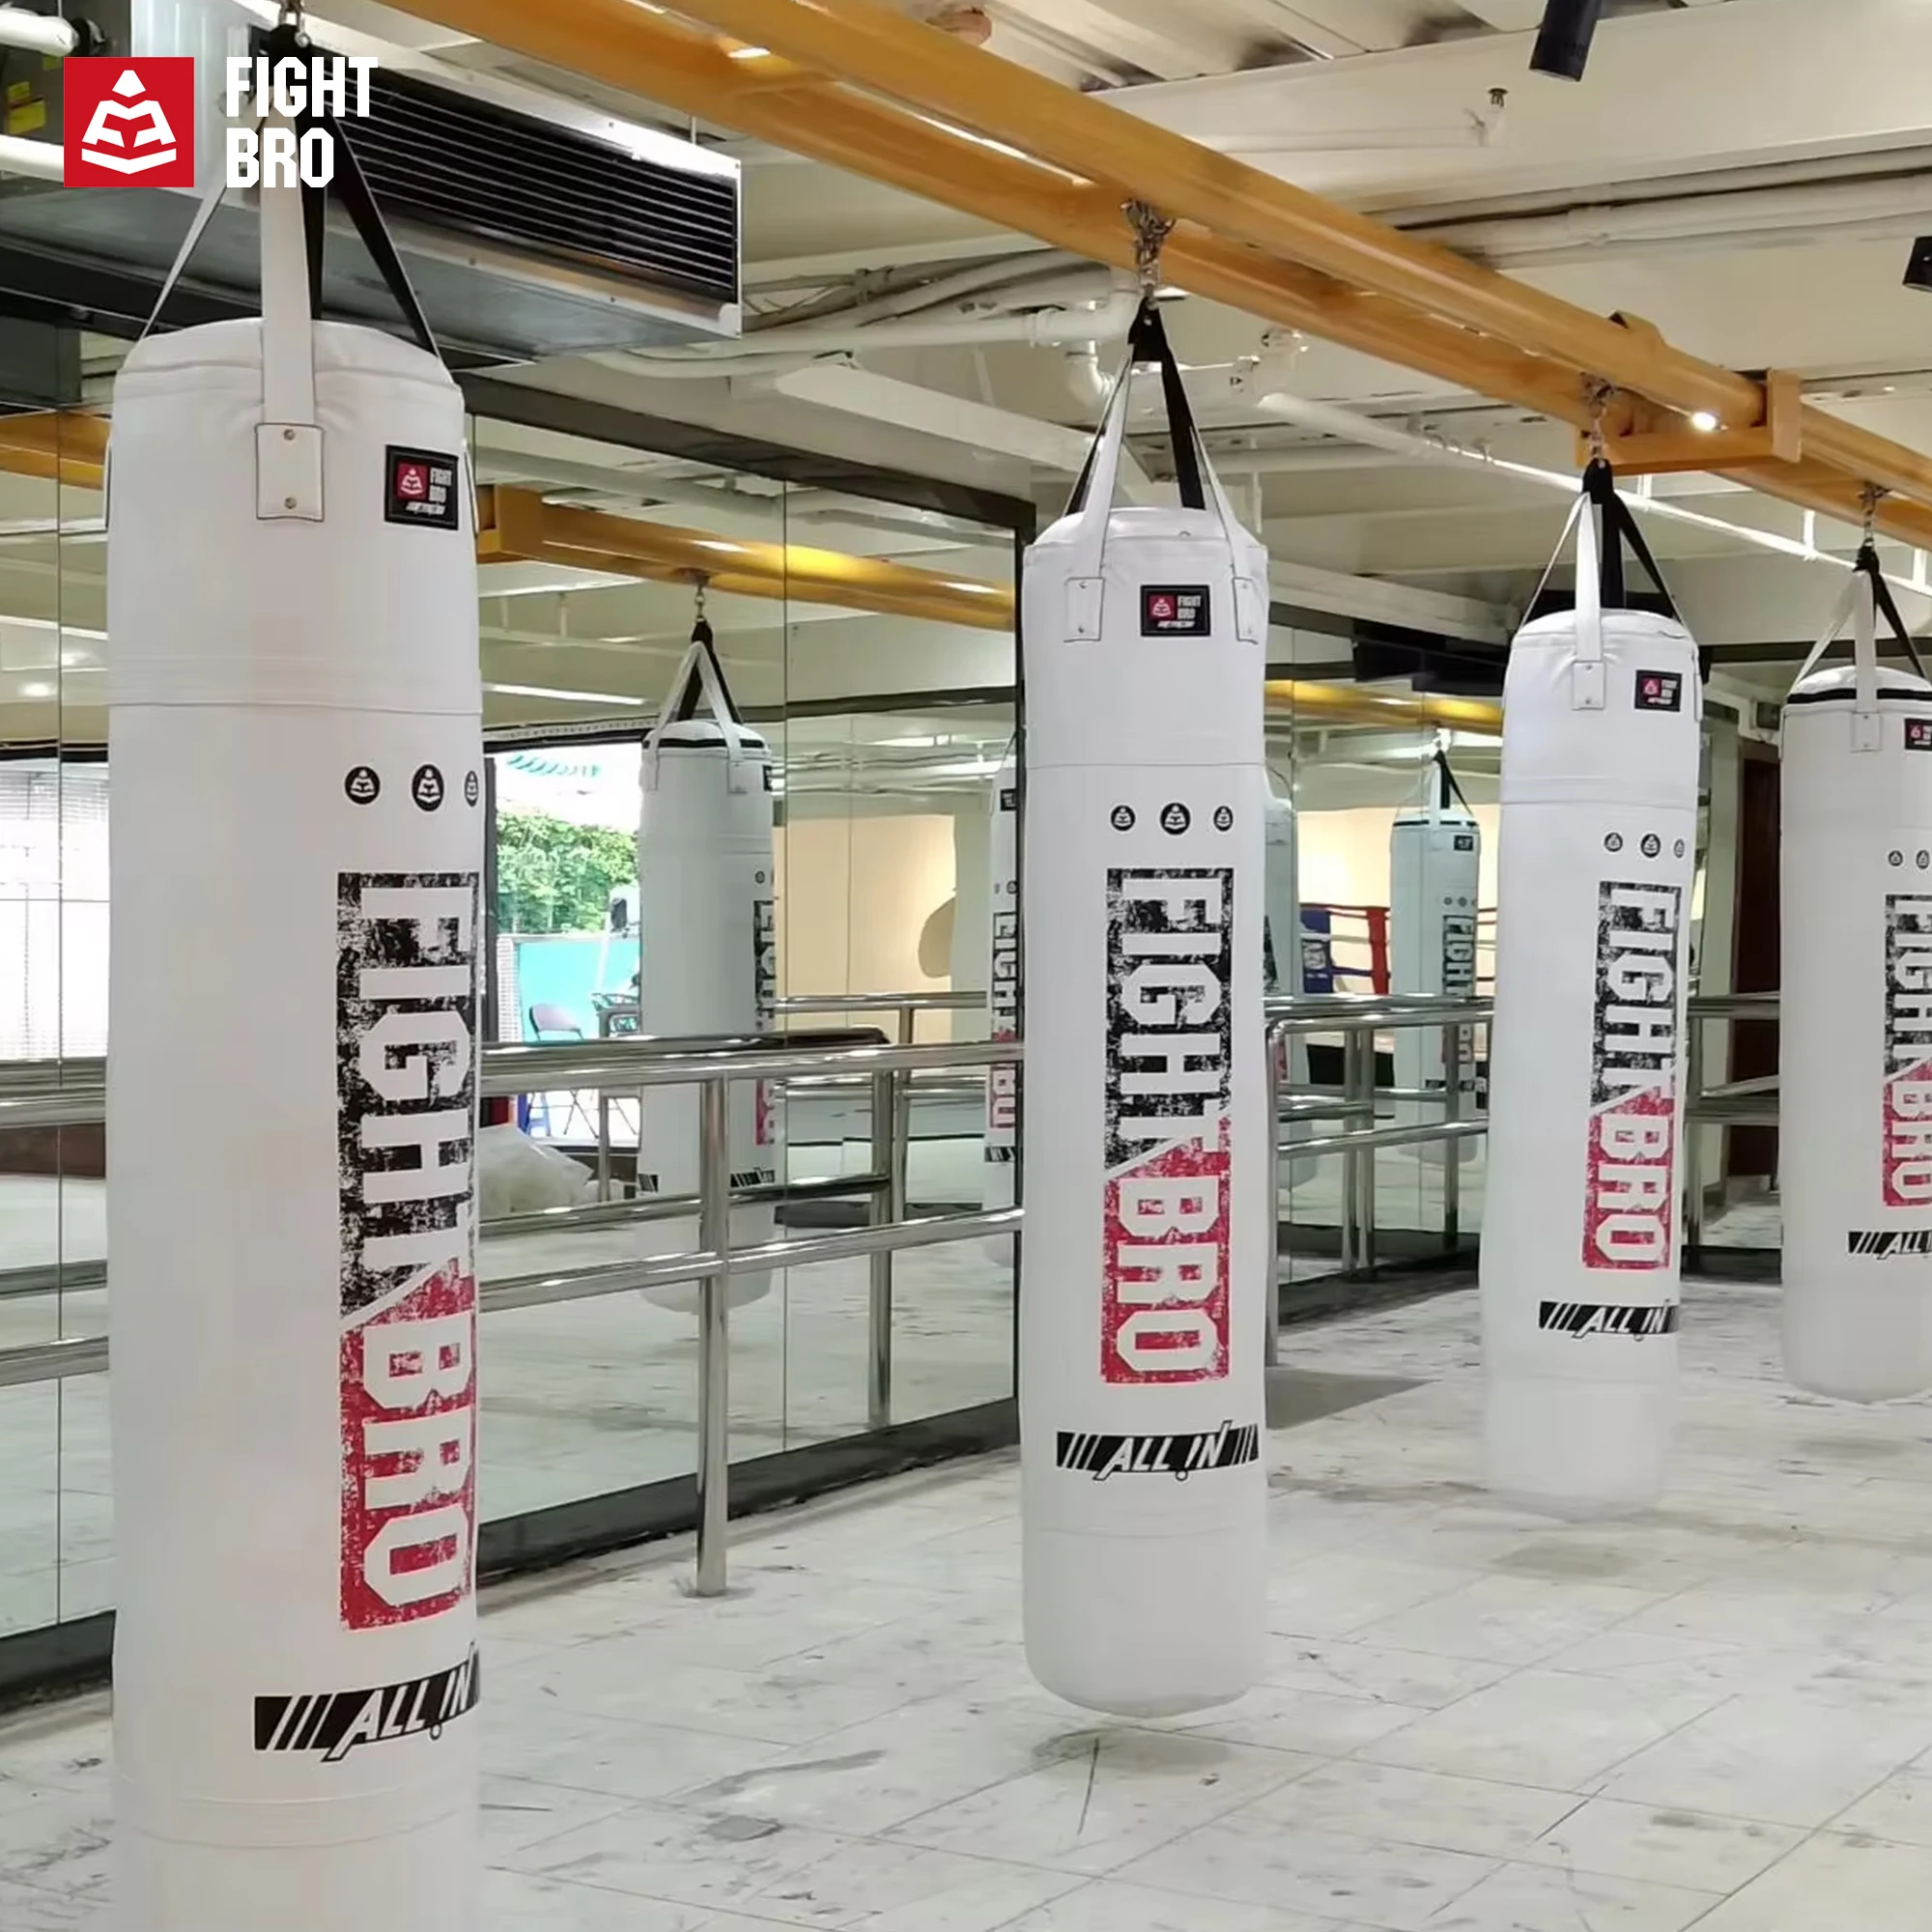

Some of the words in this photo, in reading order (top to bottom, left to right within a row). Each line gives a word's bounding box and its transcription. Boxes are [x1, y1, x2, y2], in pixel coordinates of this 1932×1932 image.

[1119, 877, 1223, 1152] FIGHT
[1602, 889, 1676, 1099] FIGHT
[360, 886, 473, 1277] FIGHT
[1595, 1113, 1669, 1261] BRO
[1877, 1232, 1922, 1260] ALL
[1117, 1175, 1219, 1372] BRO
[1573, 1307, 1634, 1338] ALL
[363, 1311, 472, 1605] BRO
[1093, 1436, 1173, 1481] ALL
[322, 1679, 429, 1762] ALL
